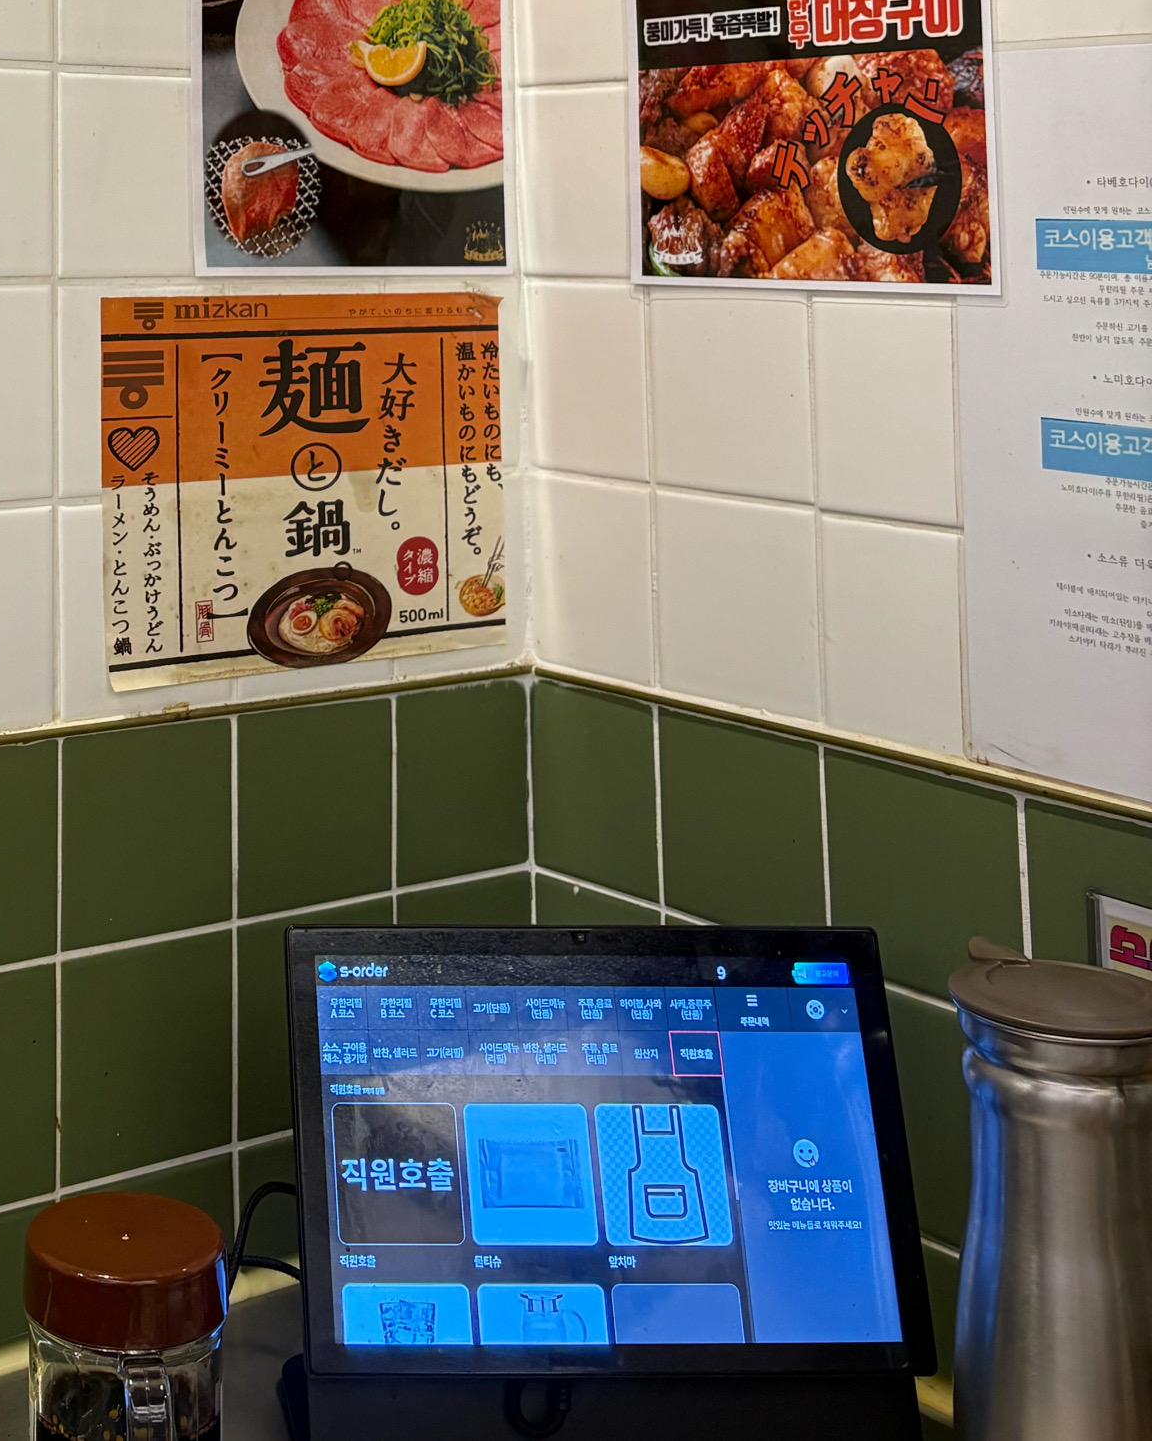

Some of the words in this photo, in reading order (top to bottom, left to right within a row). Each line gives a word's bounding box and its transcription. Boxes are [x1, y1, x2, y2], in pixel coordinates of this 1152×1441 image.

[644, 13, 711, 46] 풍미가득!
[711, 6, 781, 40] 육즙폭발!
[770, 68, 948, 191] テッチャン
[174, 298, 269, 319] mizkan
[376, 352, 418, 532] 大好きだし。
[455, 341, 482, 556] 温かいものにもどうぞ。
[417, 548, 434, 584] 濃縮
[1096, 552, 1129, 568] 소스류
[403, 549, 417, 587] タイプ
[399, 608, 444, 624] 500ml
[339, 963, 389, 978] s-order
[716, 965, 727, 980] 9
[330, 998, 363, 1009] 무한리필
[380, 998, 413, 1009] 무한리필
[429, 998, 462, 1009] 무한리필
[472, 1002, 511, 1015] 고기(단품)
[525, 998, 566, 1009] 사이드메뉴
[330, 1009, 337, 1019] A
[338, 1009, 356, 1019] 코스
[380, 1009, 387, 1019] B
[388, 1009, 406, 1019] 코스
[430, 1009, 437, 1019] C
[438, 1009, 455, 1019] 코스
[531, 1009, 553, 1020] (단품)
[580, 1009, 603, 1020] (단품)
[630, 1009, 653, 1020] (단품)
[680, 1009, 703, 1021] (단품)
[740, 1016, 770, 1028] 주문내역
[342, 1042, 368, 1053] 구이용
[426, 1047, 464, 1060] 고기(리필)
[479, 1043, 520, 1054] 사이드메뉴
[343, 1053, 368, 1064] 공기밥
[484, 1053, 507, 1065] (리필)
[535, 1053, 557, 1065] (리필)
[634, 1048, 659, 1060] 원산지
[680, 1048, 714, 1060] 직원호출
[329, 1083, 362, 1096] 직원호출
[341, 1157, 455, 1192] 직원호출
[768, 1179, 819, 1194] 장바구니에
[821, 1179, 853, 1194] 상품이
[790, 1198, 836, 1212] 없습니다.
[768, 1220, 791, 1231] 맛있는
[791, 1220, 822, 1230] 메뉴들로
[823, 1220, 863, 1230] 채워주세요!
[339, 1254, 377, 1268] 직원호출
[473, 1255, 502, 1268] 물티슈
[608, 1255, 637, 1269] 앞치마
